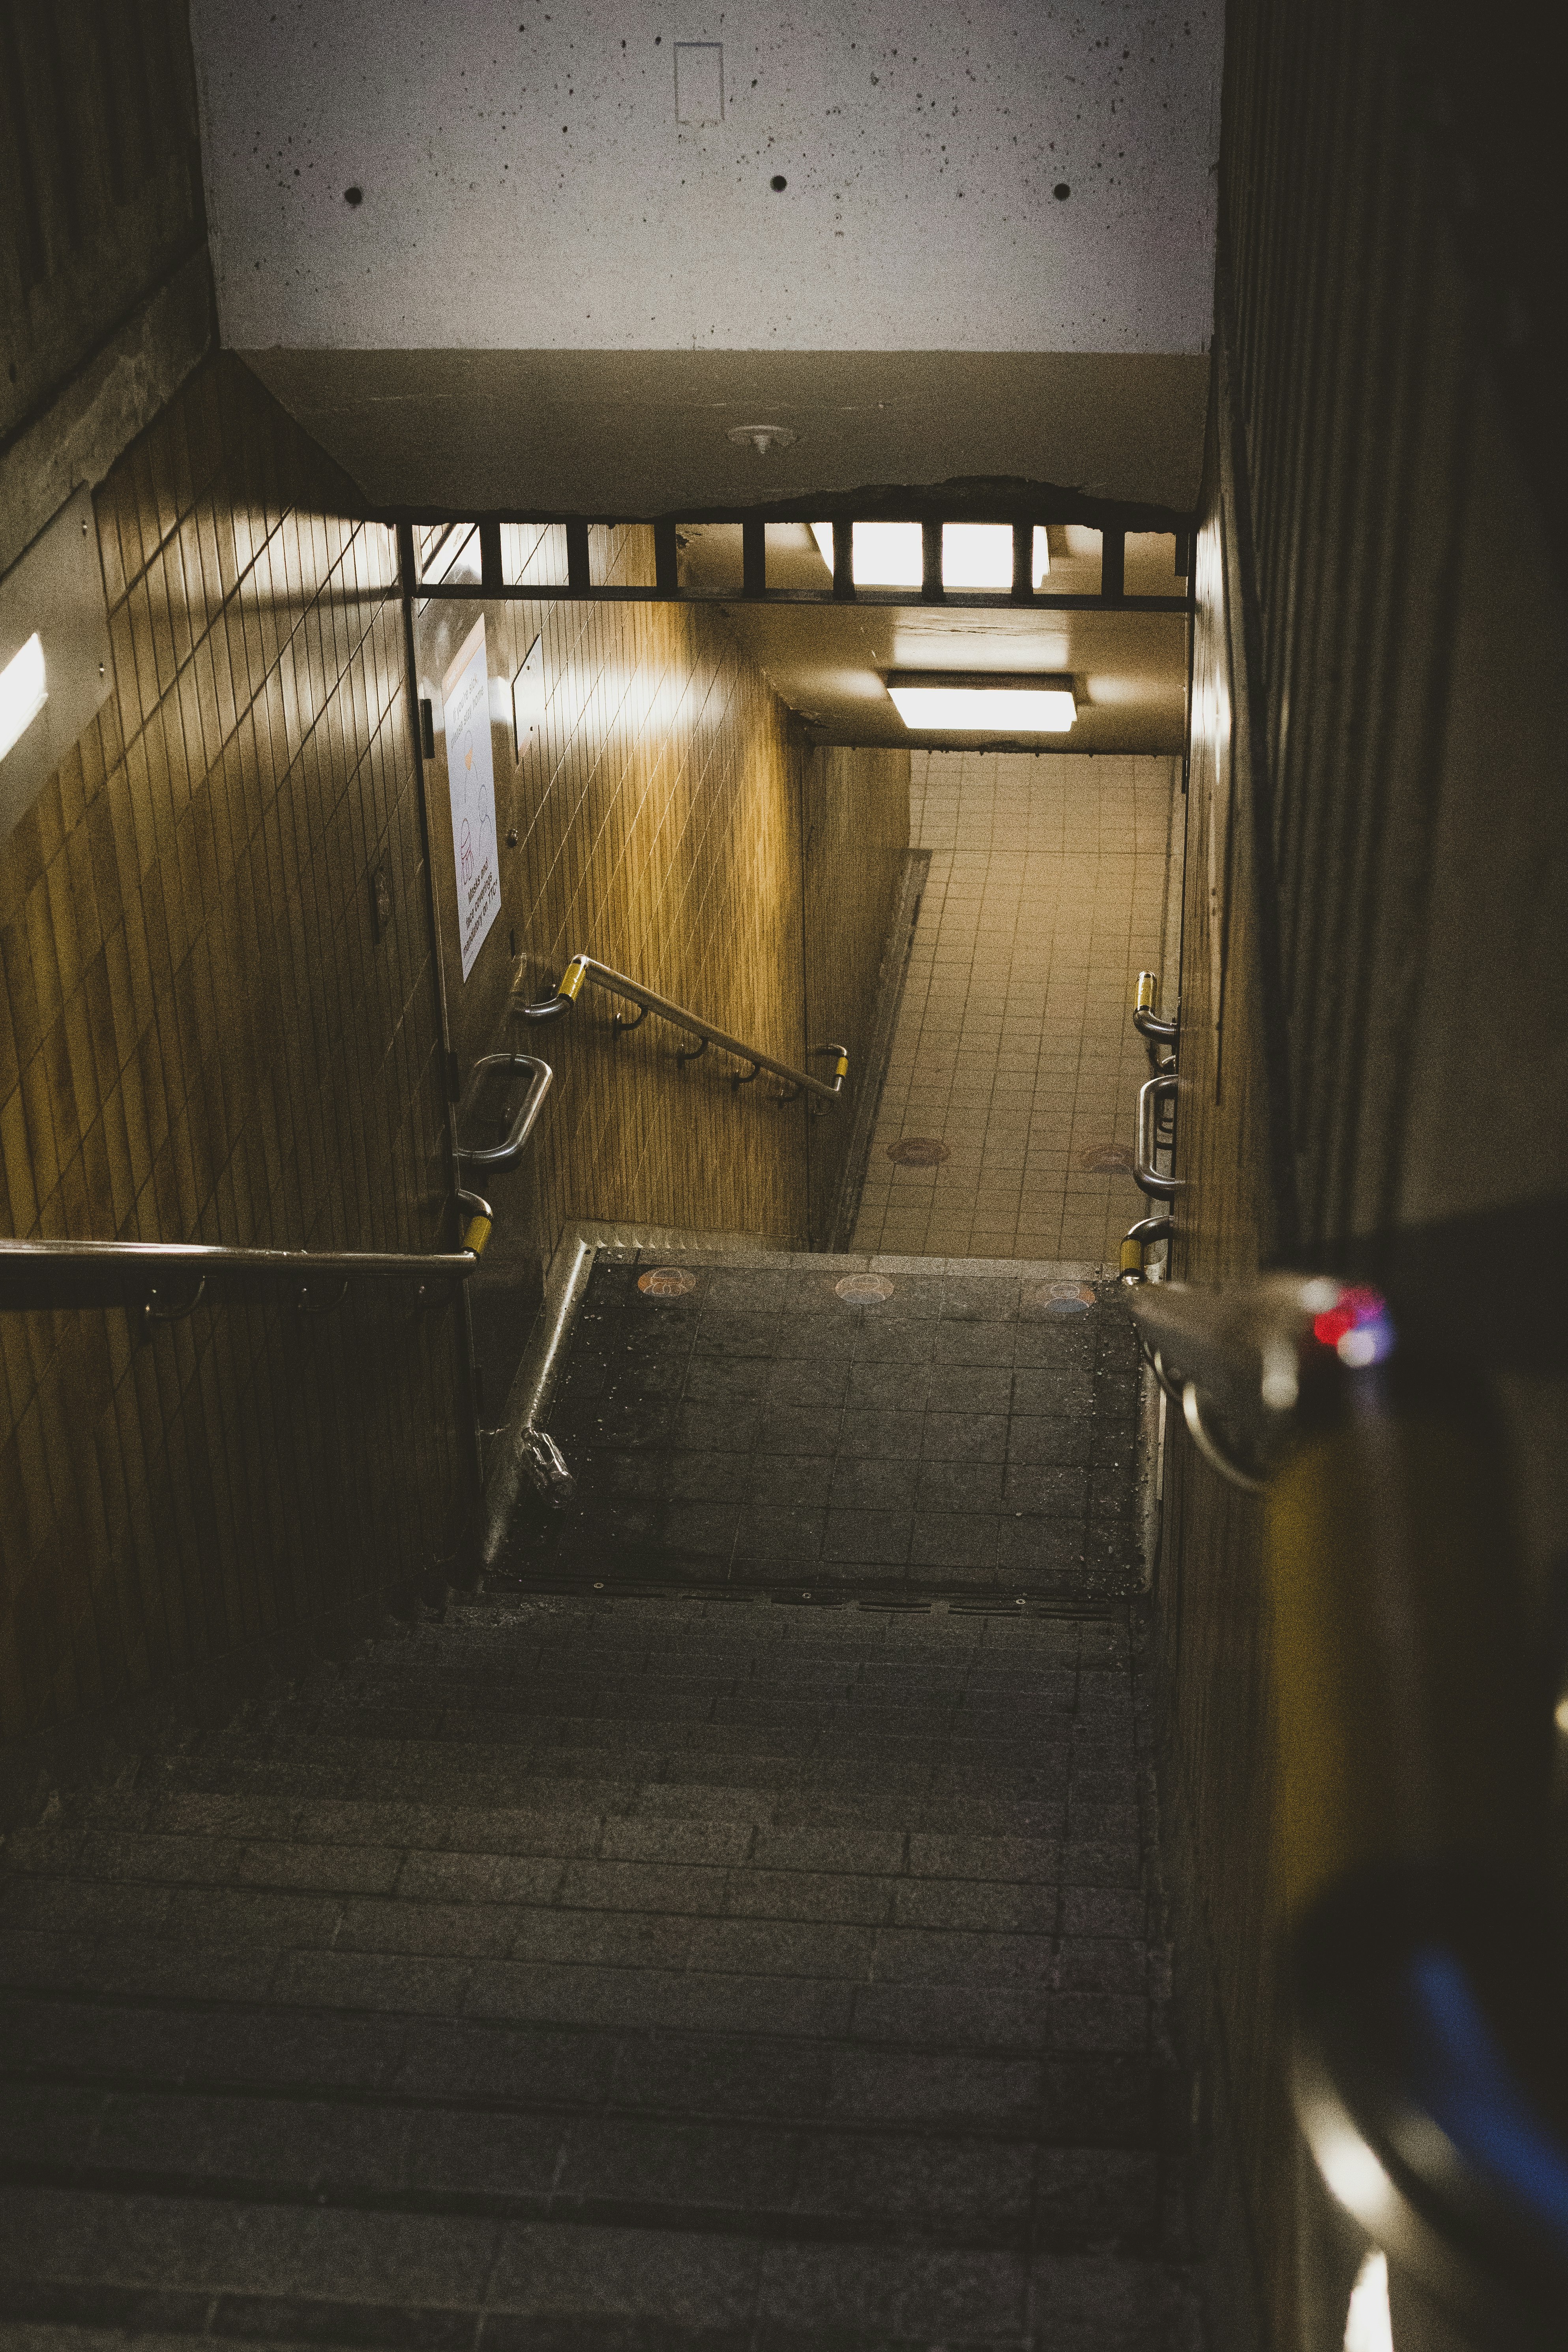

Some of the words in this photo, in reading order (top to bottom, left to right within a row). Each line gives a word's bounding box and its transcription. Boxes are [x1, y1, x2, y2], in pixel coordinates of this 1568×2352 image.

[451, 720, 463, 749] please
[472, 685, 484, 711] home
[453, 707, 456, 723] If
[468, 875, 480, 905] Masks
[475, 871, 492, 912] coverings
[463, 911, 482, 958] mandatory
[483, 901, 488, 916] on
